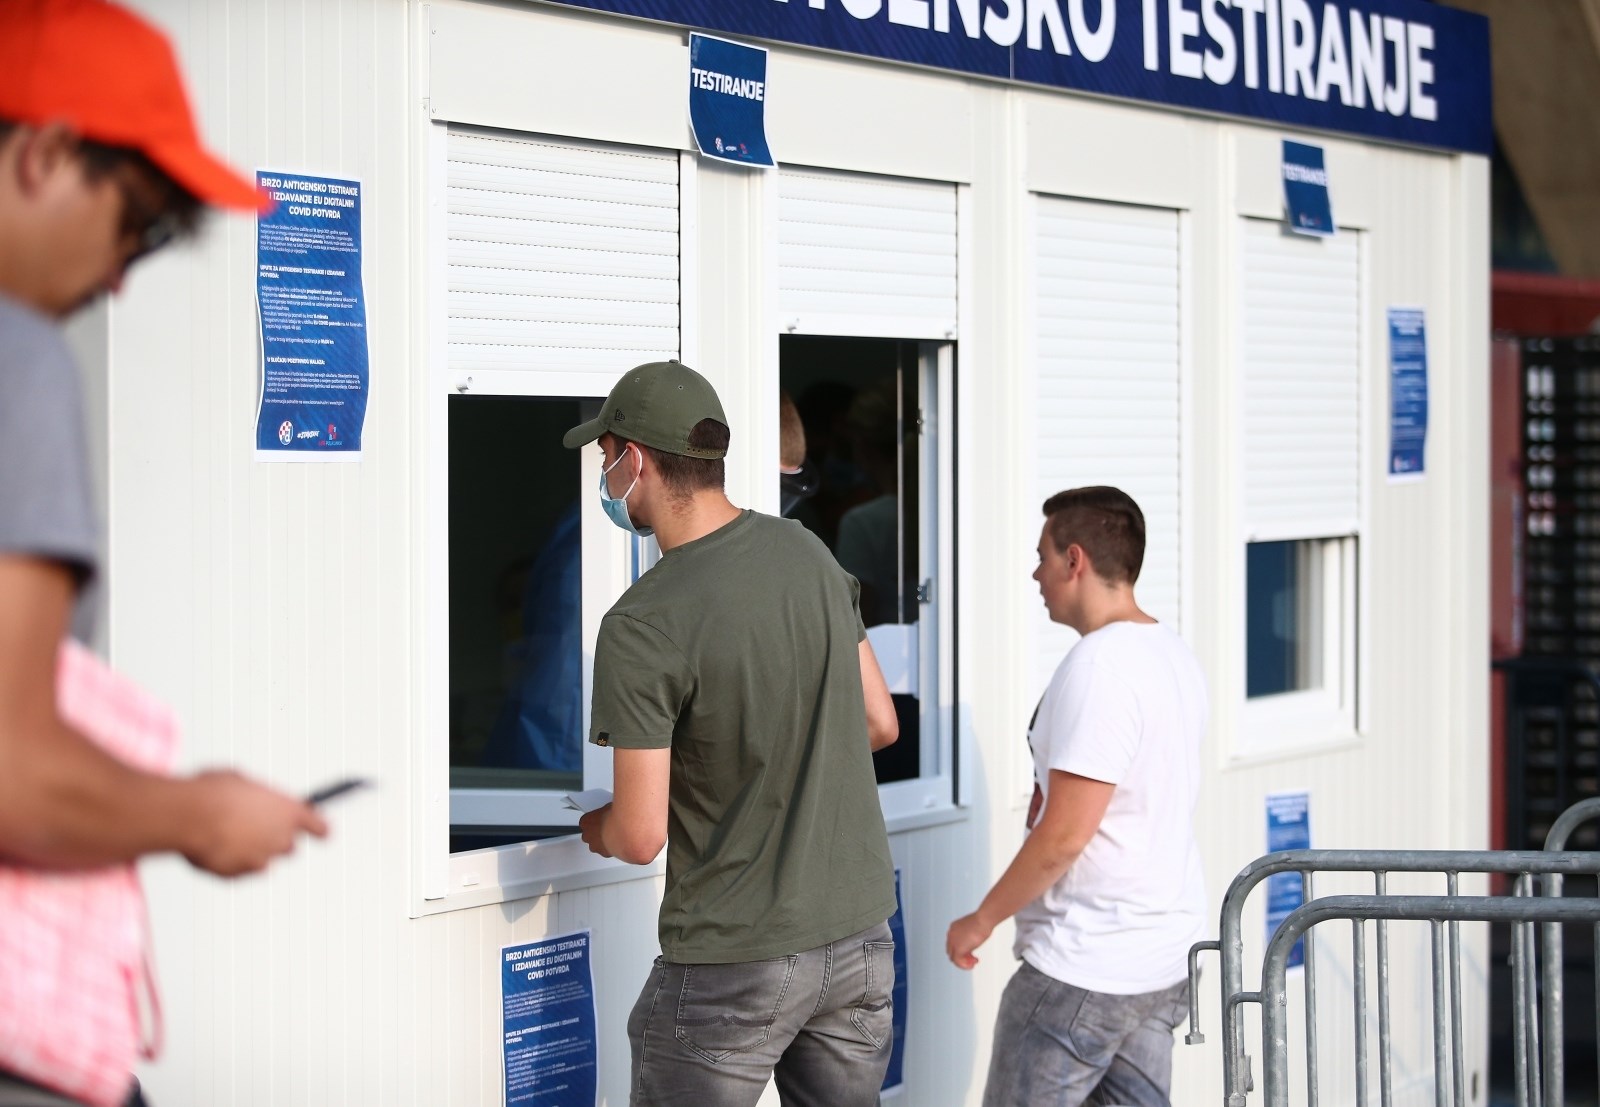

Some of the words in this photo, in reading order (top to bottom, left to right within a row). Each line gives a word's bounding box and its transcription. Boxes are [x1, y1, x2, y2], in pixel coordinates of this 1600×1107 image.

[691, 67, 764, 101] TESTIRANJE
[261, 177, 281, 188] BRZO
[283, 179, 327, 193] ANTIGENSKO
[328, 184, 358, 196] TESTIRANJE
[273, 191, 312, 204] IZDAVANJE
[313, 195, 323, 205] EU
[323, 196, 355, 208] DIGITALNIH
[289, 205, 311, 217] COVID
[312, 207, 341, 219] POTVRDA
[505, 950, 522, 962] BRZO
[522, 944, 557, 959] ANTIGENSKO
[557, 937, 587, 952] TESTIRANJE
[515, 957, 546, 972] IZDAVANJE
[546, 956, 554, 965] EU
[554, 950, 583, 963] DIGITALNIH
[527, 969, 544, 981] COVID
[545, 964, 570, 977] POTVRDA
